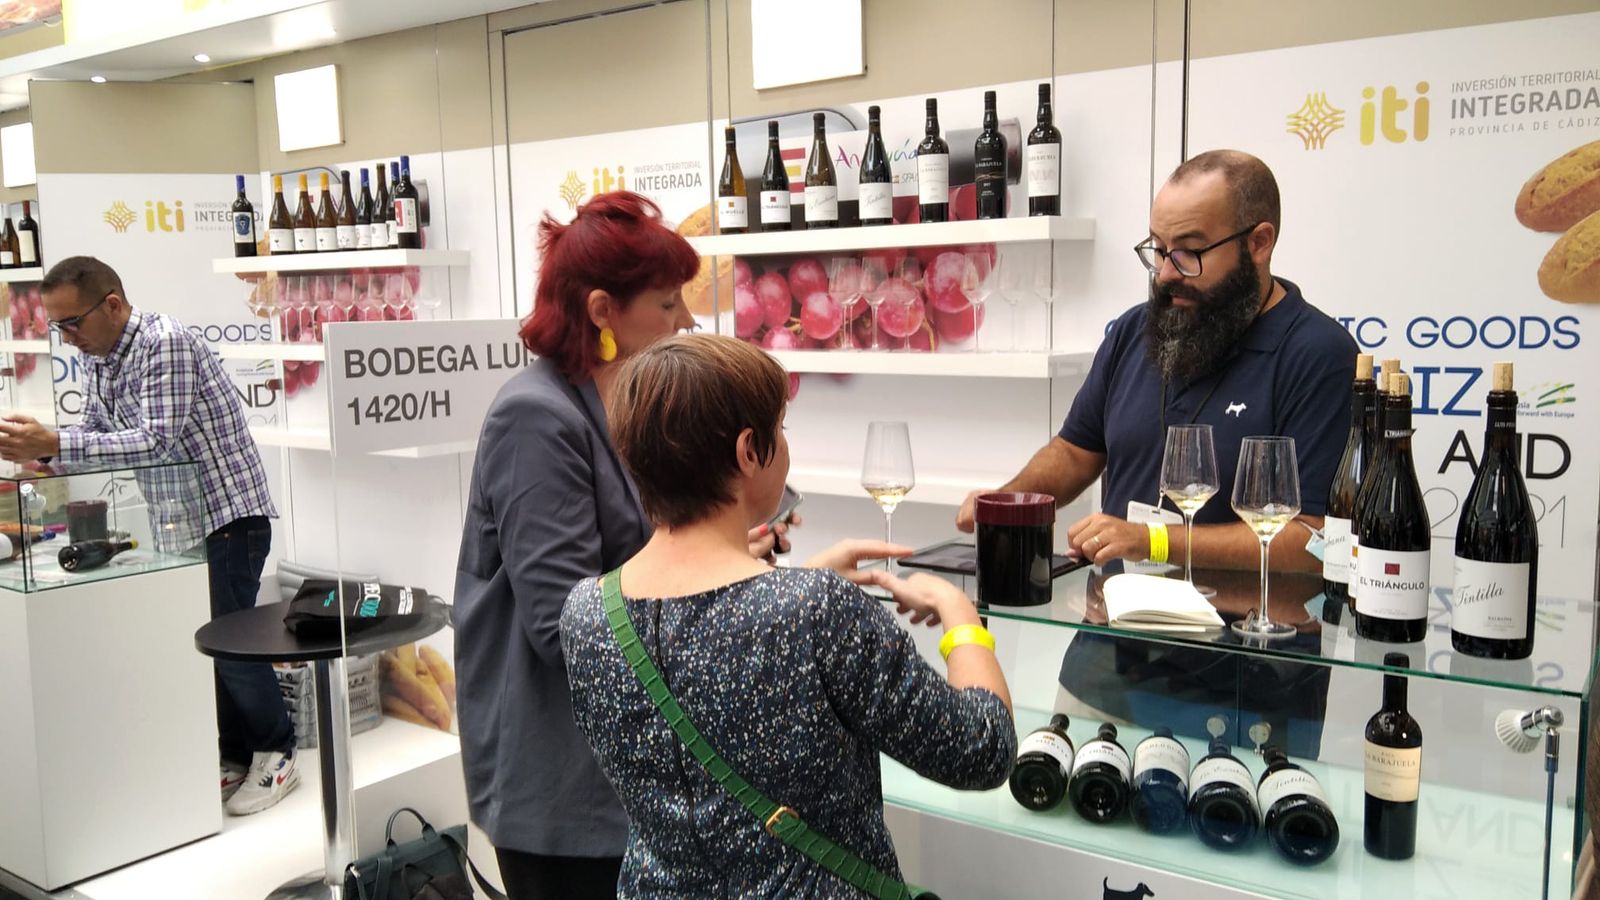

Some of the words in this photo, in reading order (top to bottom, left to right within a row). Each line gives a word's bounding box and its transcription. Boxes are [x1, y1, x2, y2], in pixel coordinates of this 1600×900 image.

[1451, 74, 1517, 93] INVERSIÓN
[1520, 69, 1600, 87] TERRITORIAL
[1360, 81, 1430, 146] iti
[1451, 86, 1600, 119] INTEGRADA
[1450, 122, 1525, 136] PROVINCIA
[1533, 120, 1549, 131] DE
[1558, 116, 1600, 129] CÁDIZ
[665, 161, 701, 171] TERRITORIAL
[634, 172, 702, 191] INTEGRADA
[145, 200, 184, 232] iti
[1406, 316, 1581, 349] GOODS
[344, 344, 479, 379] BODEGA
[486, 341, 534, 370] LUI
[347, 389, 451, 426] 1420/H
[1554, 410, 1575, 419] Europe
[1438, 430, 1571, 480] AD
[1360, 576, 1368, 585] EL
[1369, 578, 1425, 591] TRIÁNGULO
[1455, 581, 1505, 608] Tintilla
